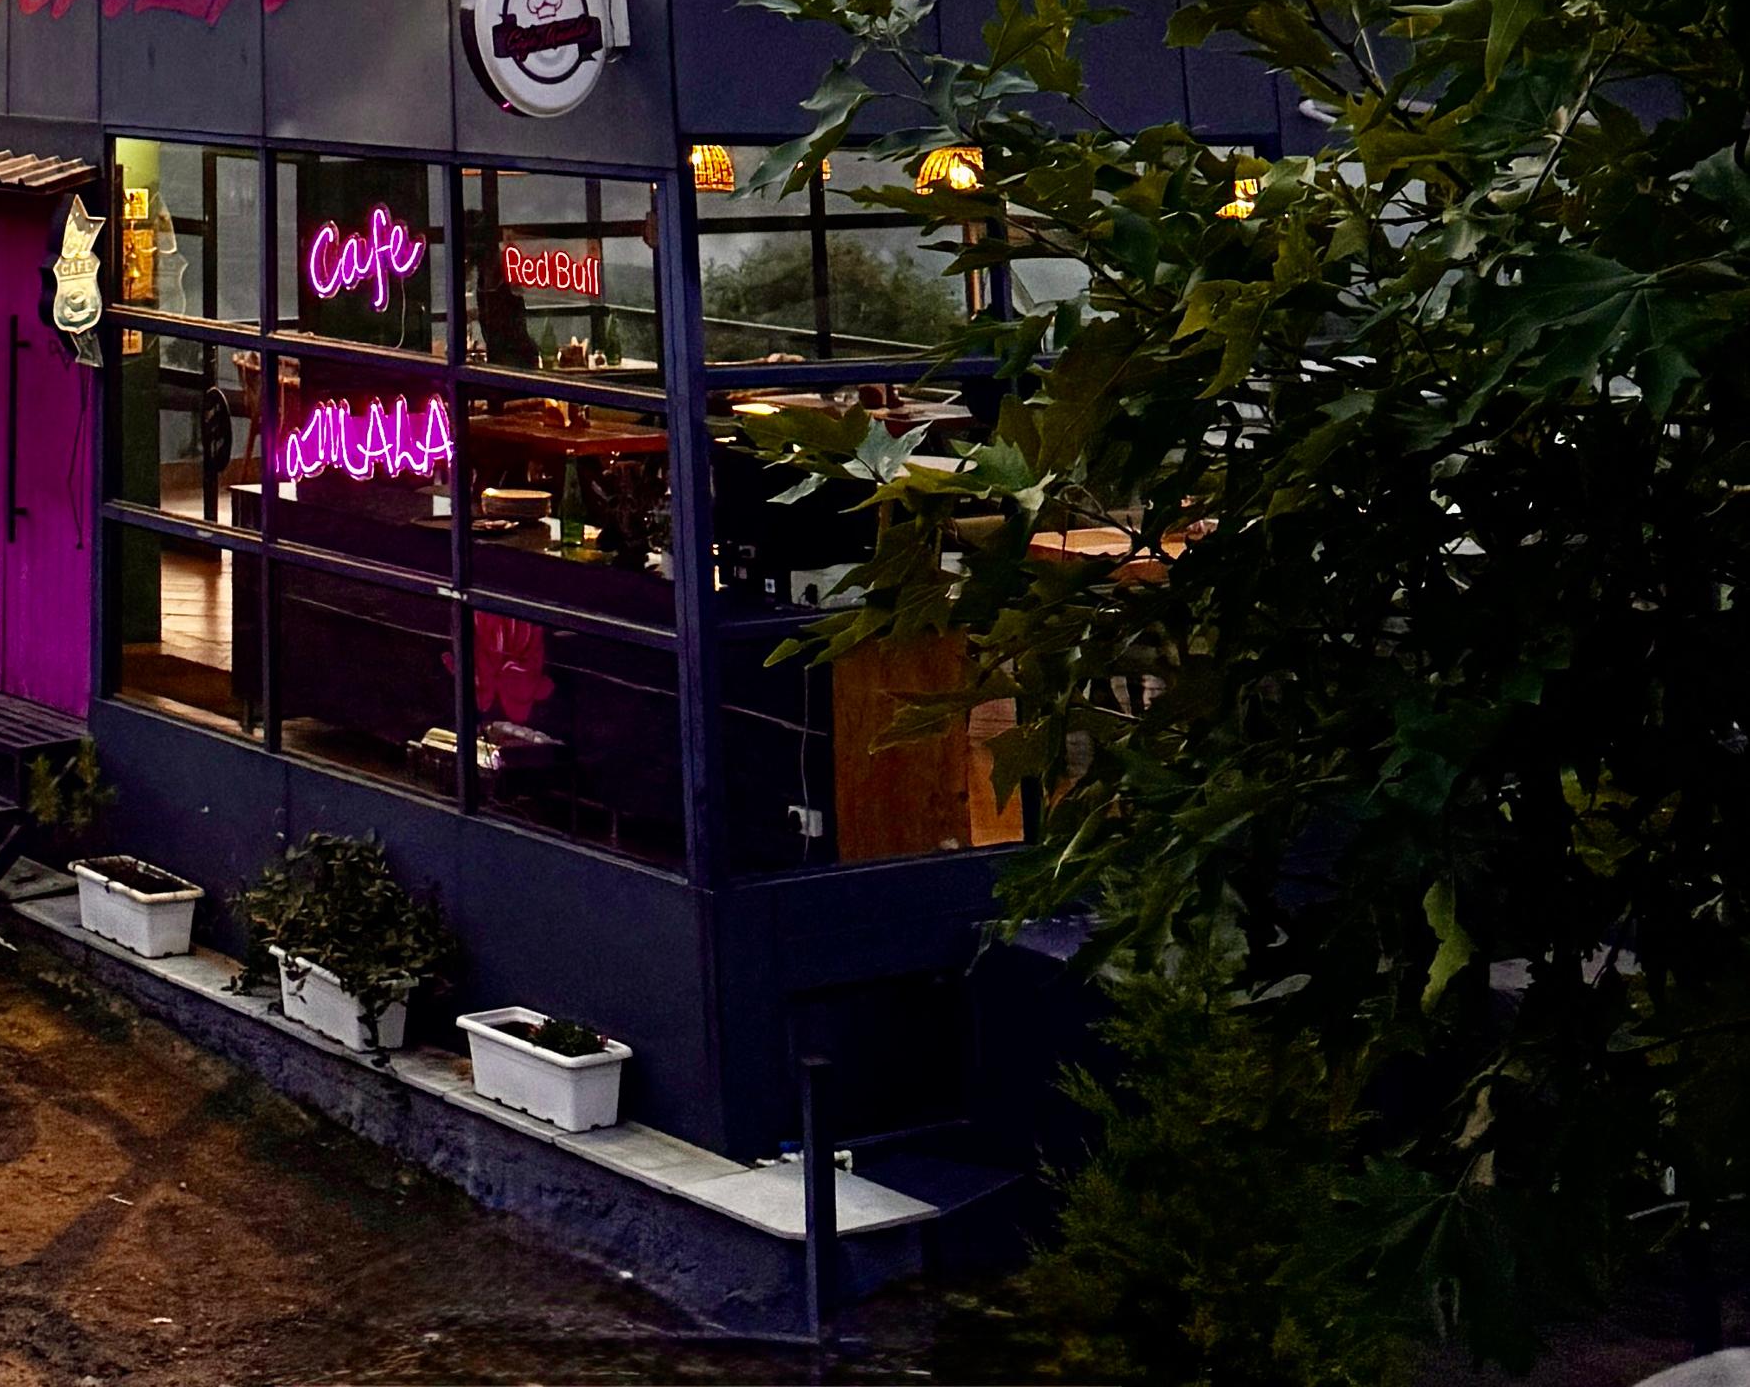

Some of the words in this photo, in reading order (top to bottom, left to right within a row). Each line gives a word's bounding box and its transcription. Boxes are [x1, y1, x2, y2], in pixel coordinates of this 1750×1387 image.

[309, 206, 425, 310] Cafe
[505, 246, 550, 287] Red
[555, 251, 599, 295] Bull
